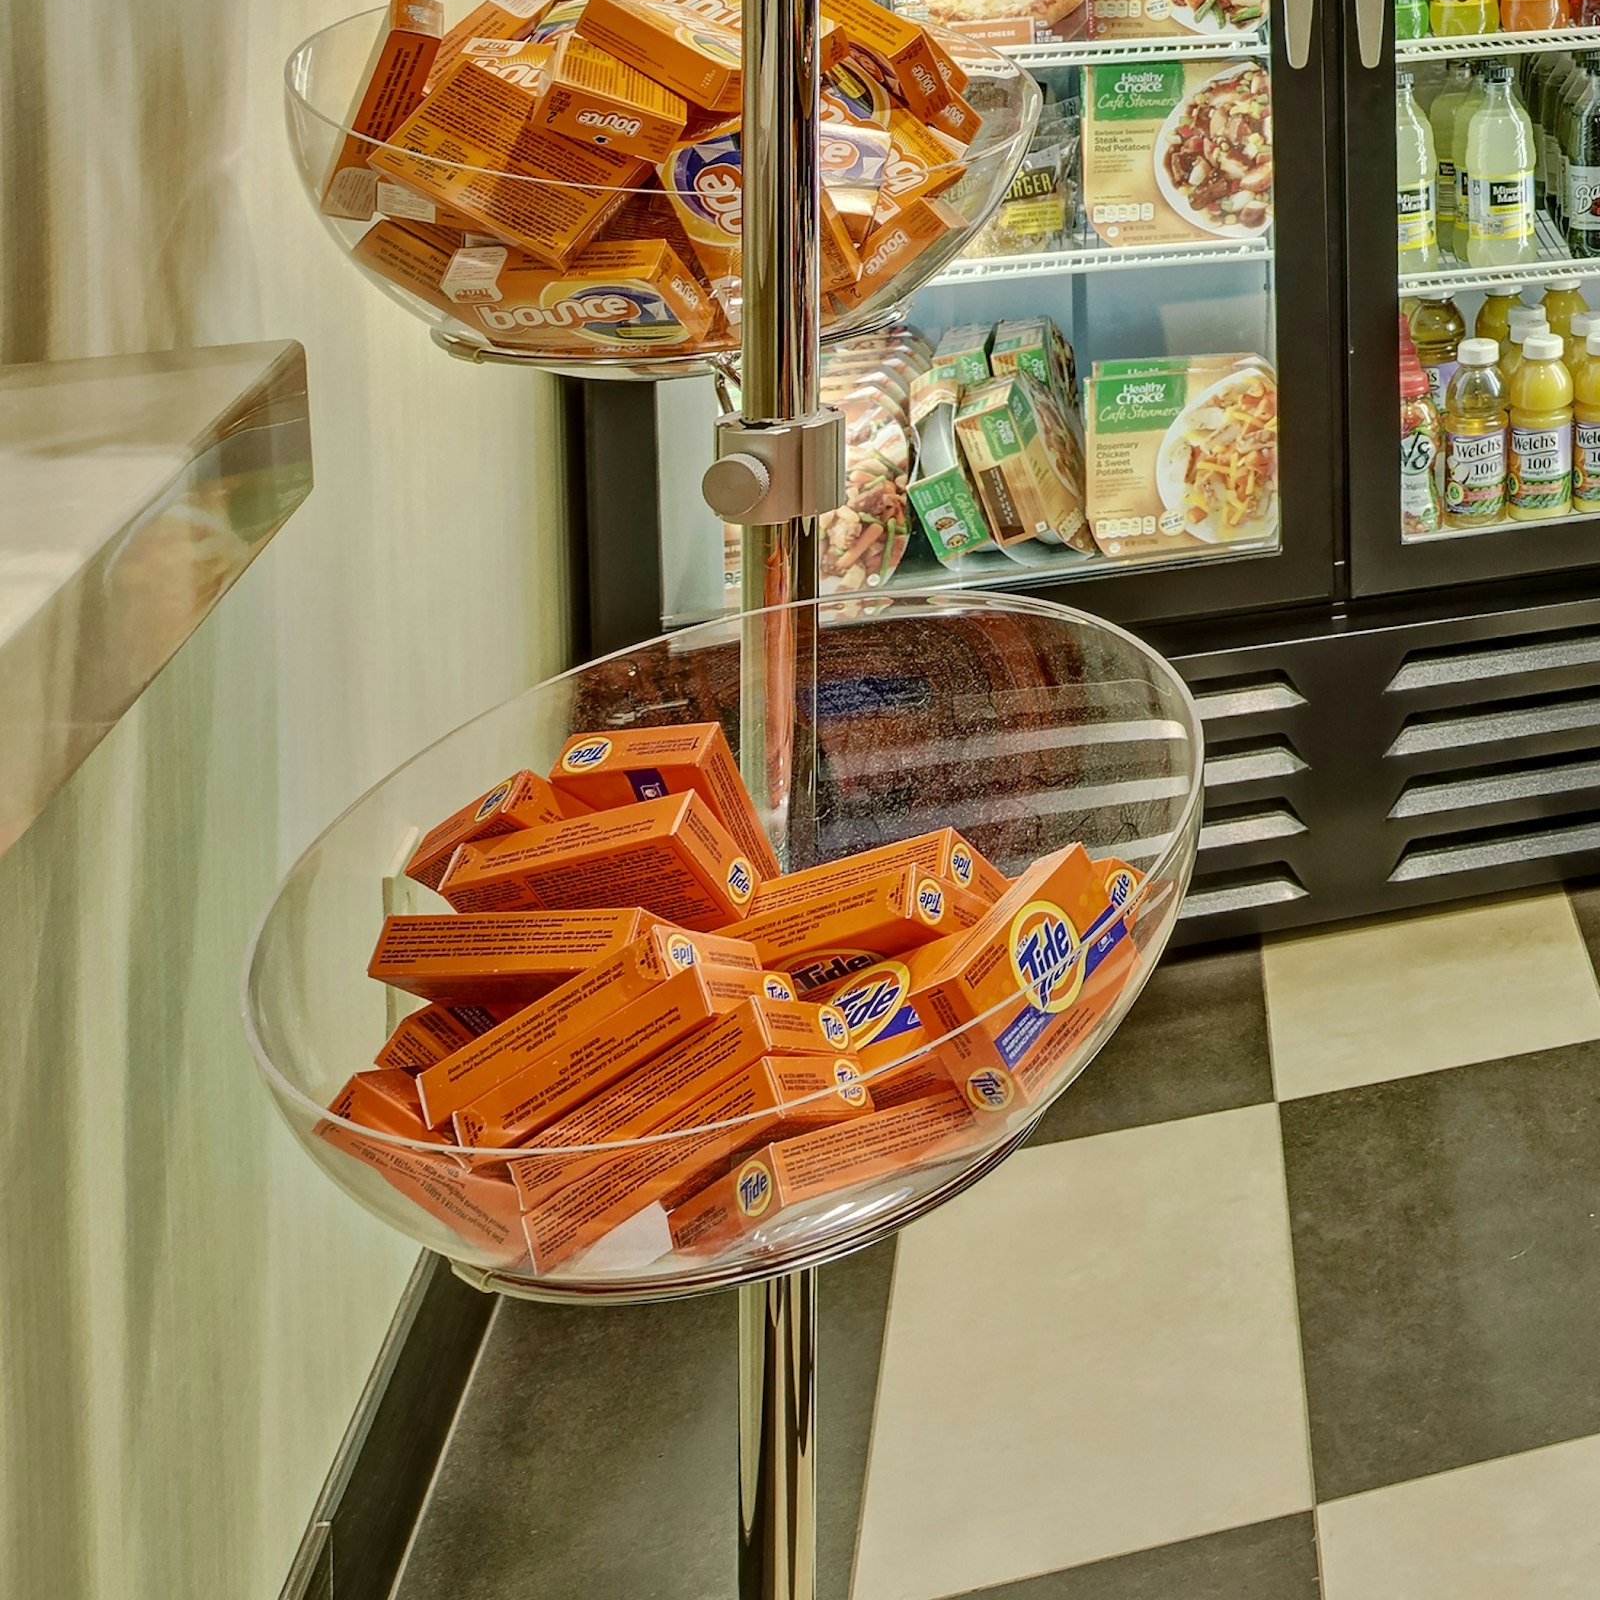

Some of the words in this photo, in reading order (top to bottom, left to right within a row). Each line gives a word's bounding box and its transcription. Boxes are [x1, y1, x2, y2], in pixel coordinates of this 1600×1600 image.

[1121, 72, 1164, 84] Healthy
[1114, 80, 1163, 94] Choice
[1125, 94, 1177, 109] Steamers
[1094, 136, 1118, 144] Steak
[1094, 144, 1112, 153] Red
[1113, 143, 1151, 152] Potatoes
[478, 296, 630, 330] bounce
[1123, 382, 1166, 395] Healthy
[1116, 392, 1165, 406] Choice
[1128, 405, 1180, 419] Steamers
[1096, 440, 1139, 452] Rosemary
[1511, 430, 1557, 452] Welch's
[1096, 449, 1130, 459] Chicken
[1104, 457, 1131, 467] Sweet
[1096, 466, 1134, 476] Potatoes
[727, 865, 750, 894] Tide
[822, 1016, 844, 1040] Tide
[740, 1171, 768, 1210] Tide
